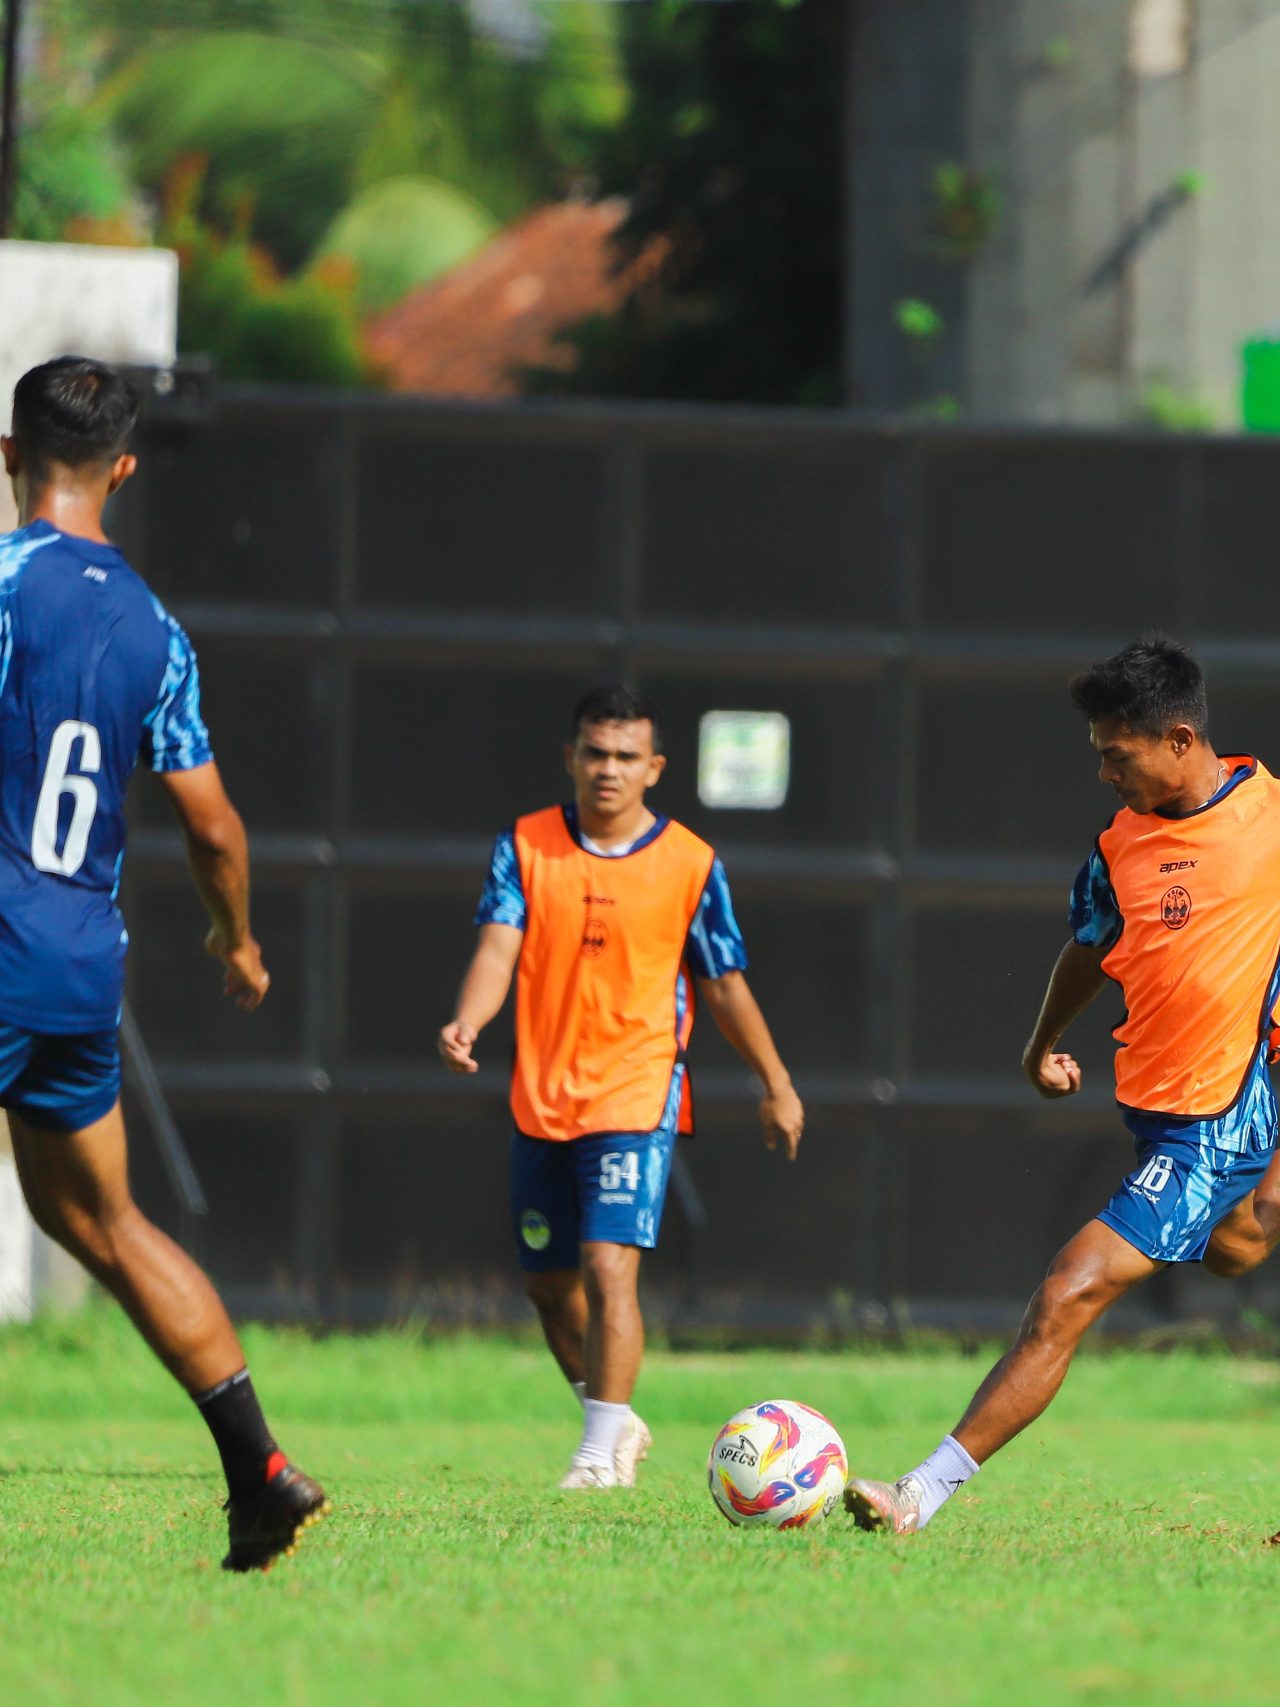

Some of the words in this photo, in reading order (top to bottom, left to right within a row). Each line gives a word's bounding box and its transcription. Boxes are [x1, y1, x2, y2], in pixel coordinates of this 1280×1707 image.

[32, 719, 102, 877] 6
[1159, 860, 1199, 874] apex
[599, 1151, 641, 1191] 54
[719, 1447, 758, 1467] SPECS
